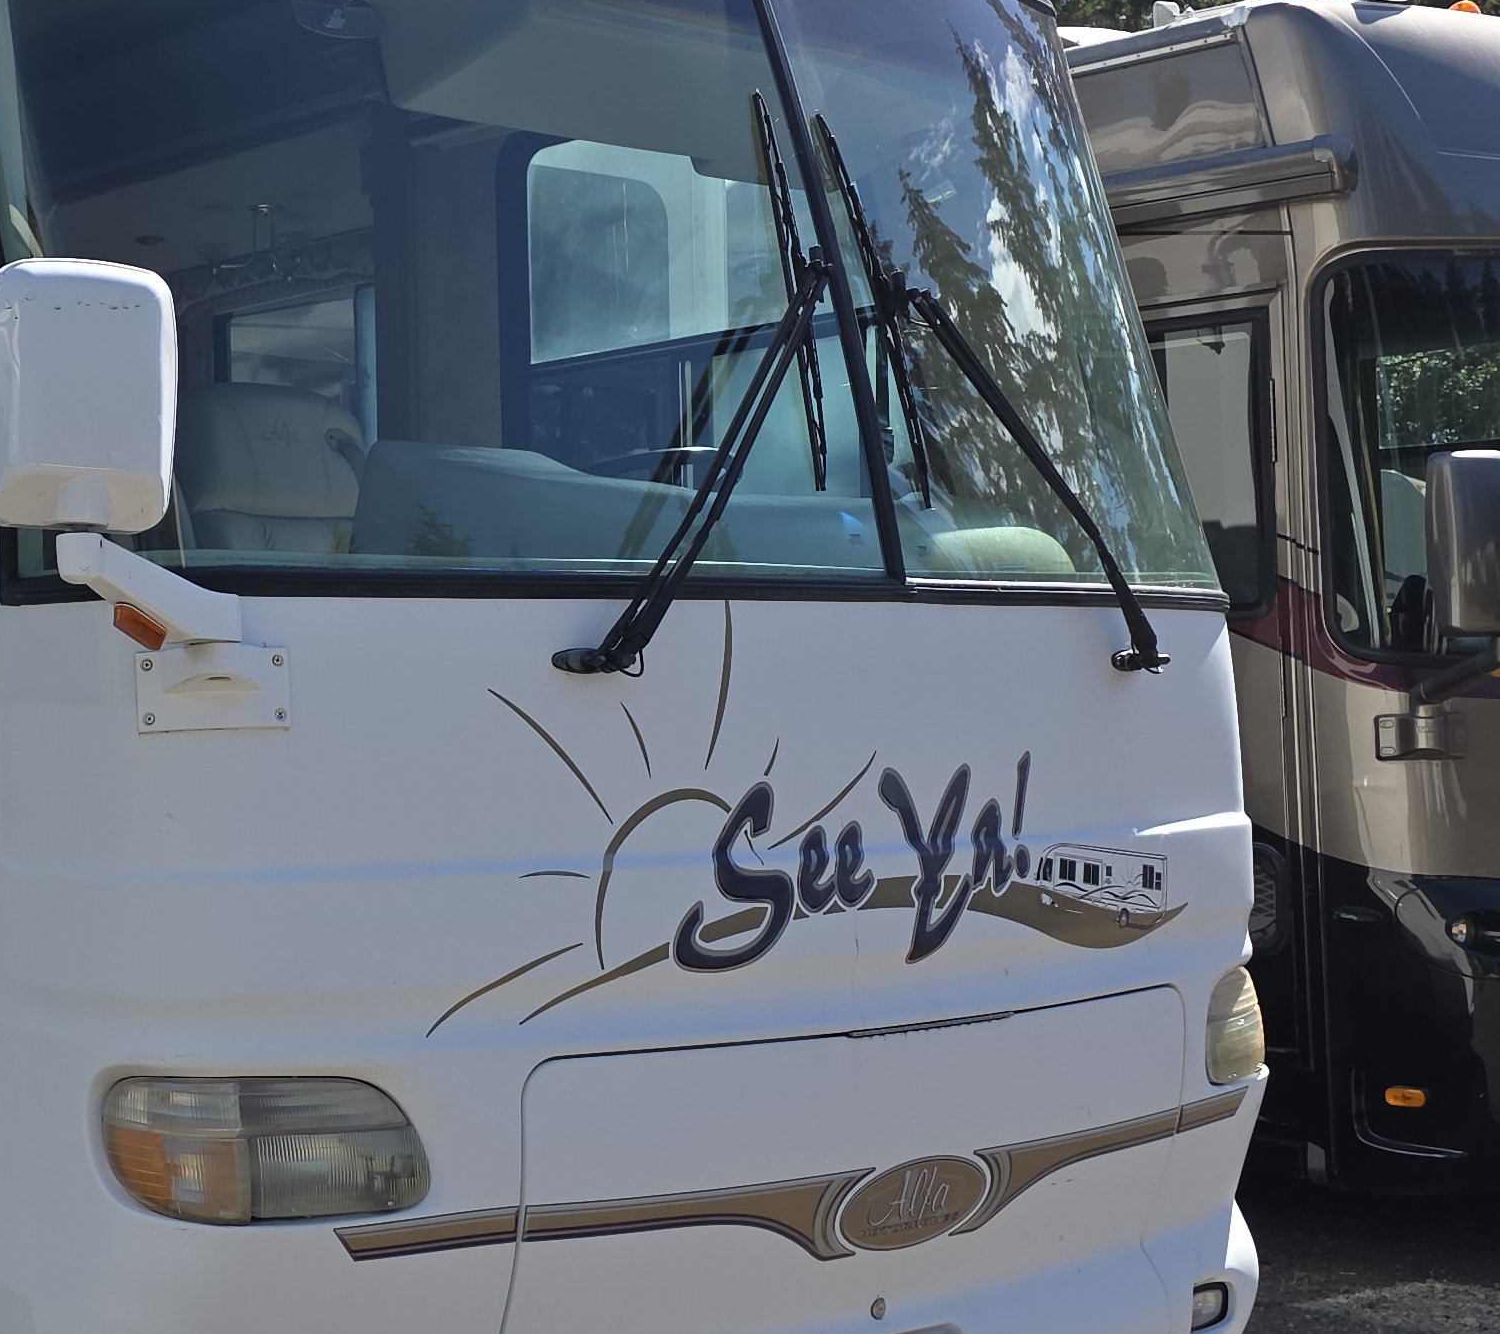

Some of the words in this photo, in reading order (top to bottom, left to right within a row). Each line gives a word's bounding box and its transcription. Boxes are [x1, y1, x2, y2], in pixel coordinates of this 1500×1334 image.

[673, 781, 874, 973] See
[878, 750, 1031, 964] Ya!
[867, 1166, 949, 1228] Alfa
